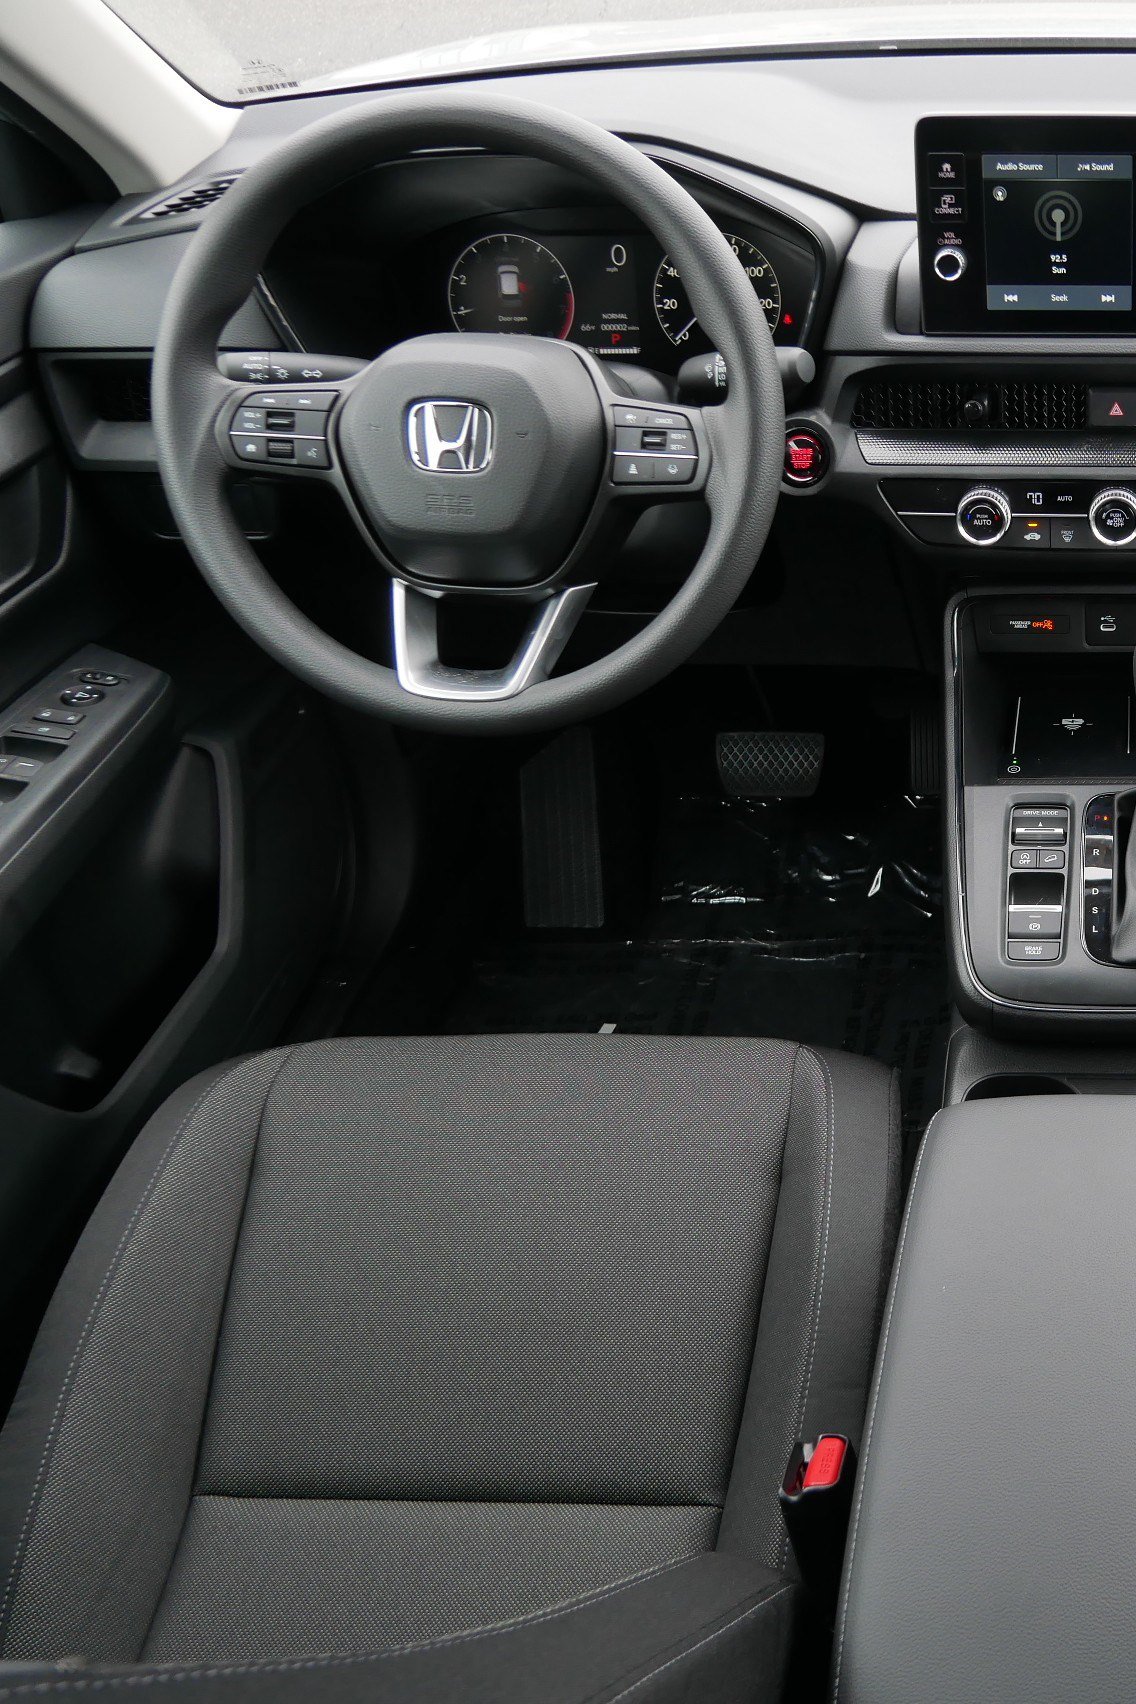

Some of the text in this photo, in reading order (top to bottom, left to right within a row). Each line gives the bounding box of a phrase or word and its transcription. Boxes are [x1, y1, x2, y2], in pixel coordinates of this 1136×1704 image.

[996, 163, 1043, 171] Audio Source
[1091, 163, 1114, 171] Sound
[611, 244, 627, 266] 0
[1050, 254, 1067, 263] 92.5
[1052, 266, 1067, 274] Sun
[459, 275, 467, 285] 2
[1051, 294, 1069, 302] Seek
[663, 299, 678, 310] 20
[612, 333, 622, 345] P
[1027, 492, 1042, 505] 70
